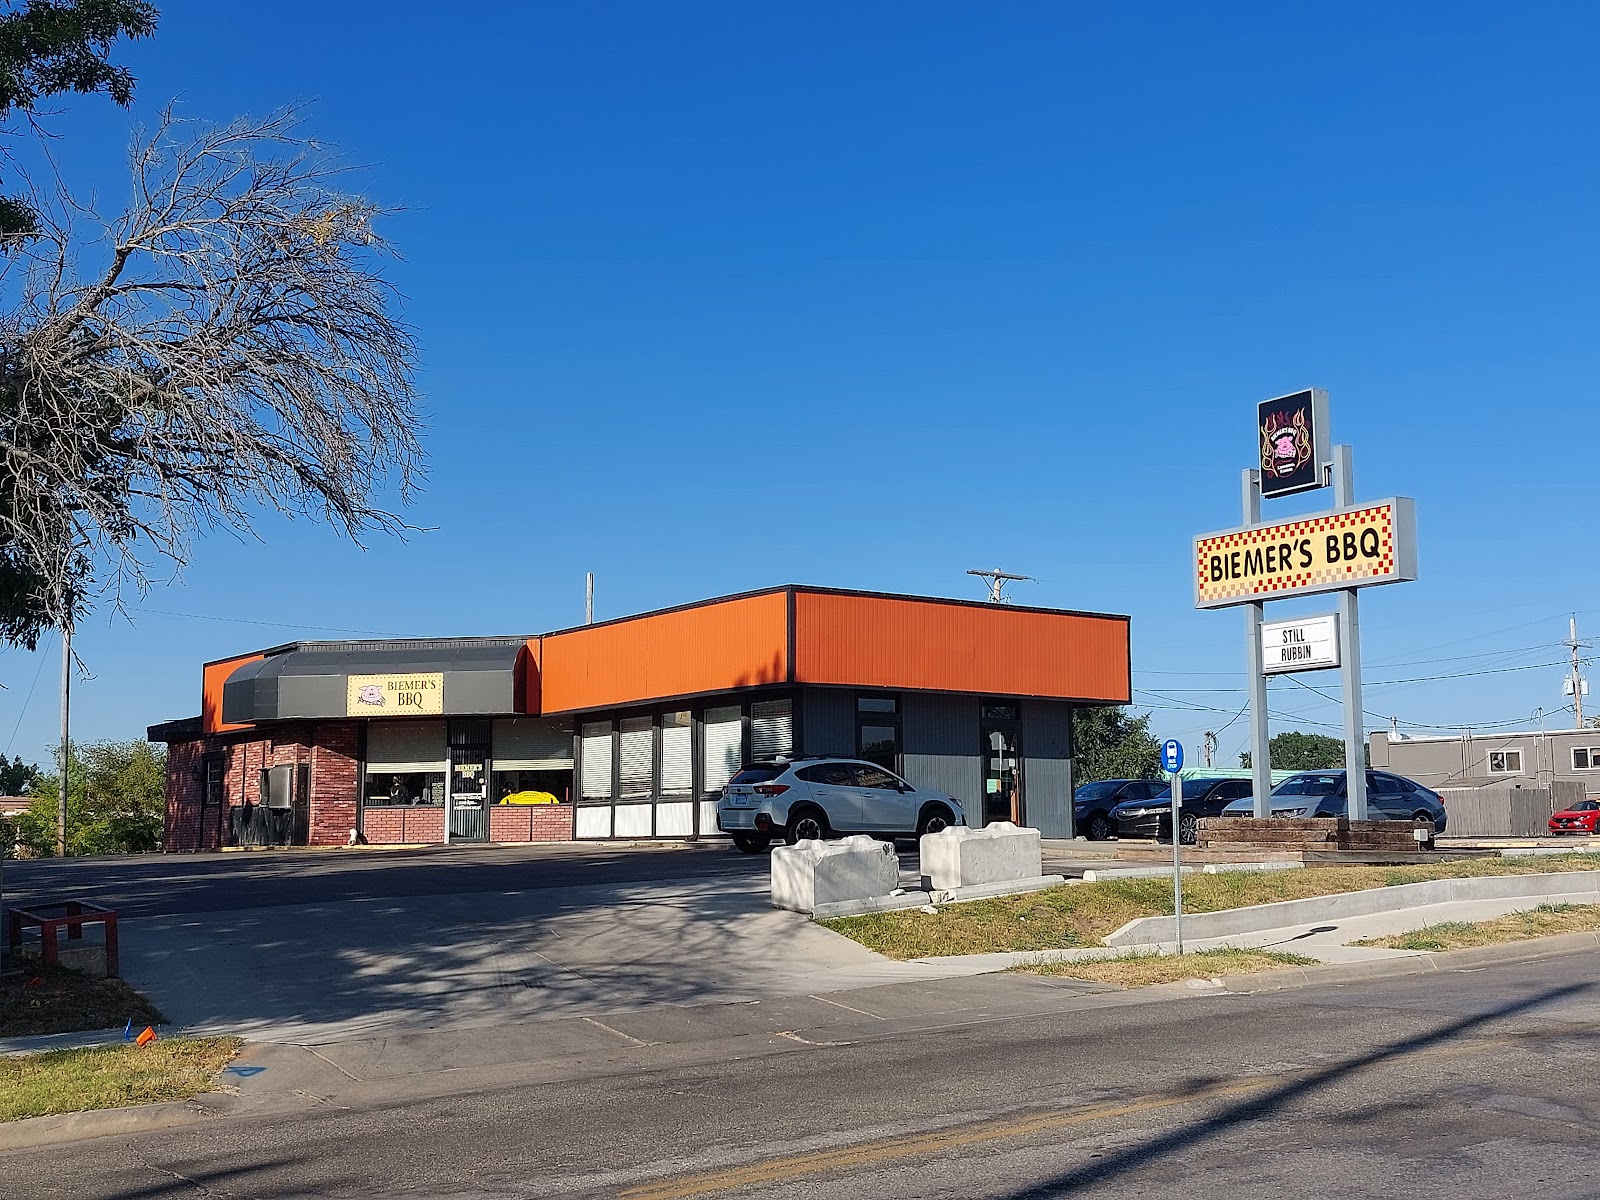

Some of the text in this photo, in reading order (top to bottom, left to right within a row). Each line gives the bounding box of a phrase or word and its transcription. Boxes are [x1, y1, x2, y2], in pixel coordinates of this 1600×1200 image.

[1210, 527, 1380, 582] BIEMER'S BBQ
[1282, 628, 1305, 644] STILL
[1281, 645, 1311, 662] RUBBIN
[387, 679, 436, 691] BIEMER'S
[398, 691, 423, 709] BBQ
